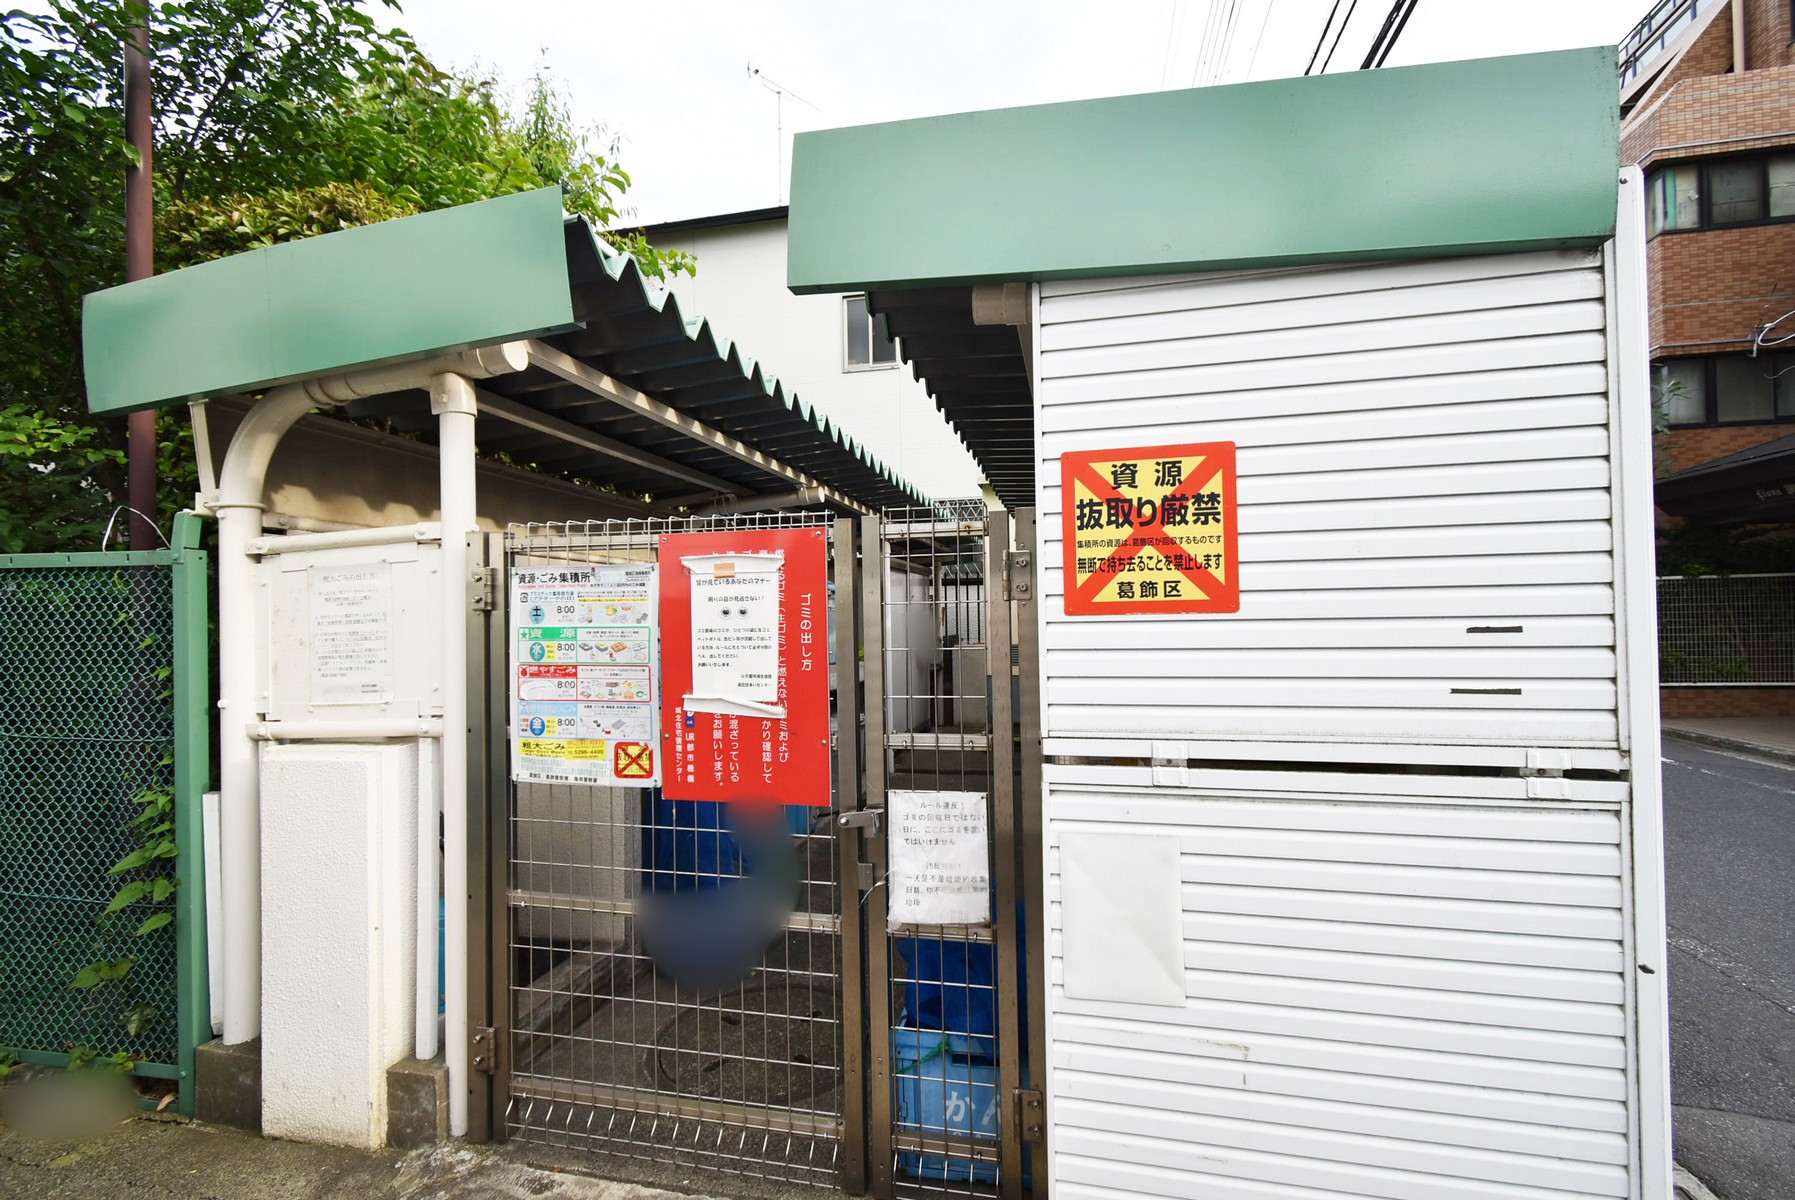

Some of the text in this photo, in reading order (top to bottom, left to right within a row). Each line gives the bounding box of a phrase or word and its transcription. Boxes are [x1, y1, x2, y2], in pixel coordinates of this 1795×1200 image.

[1111, 460, 1183, 490] 資源
[1076, 492, 1222, 531] 抜取り厳禁
[1077, 535, 1223, 549] 集積所の資源は、葛飾区が回収するものです
[1077, 552, 1223, 574] 無断で持ち去ることを禁止します
[1117, 580, 1183, 599] 葛飾区
[556, 605, 575, 614] 8:00
[800, 593, 813, 671] ゴミの出し方
[557, 643, 575, 652] 8:00
[557, 718, 576, 727] 8:00
